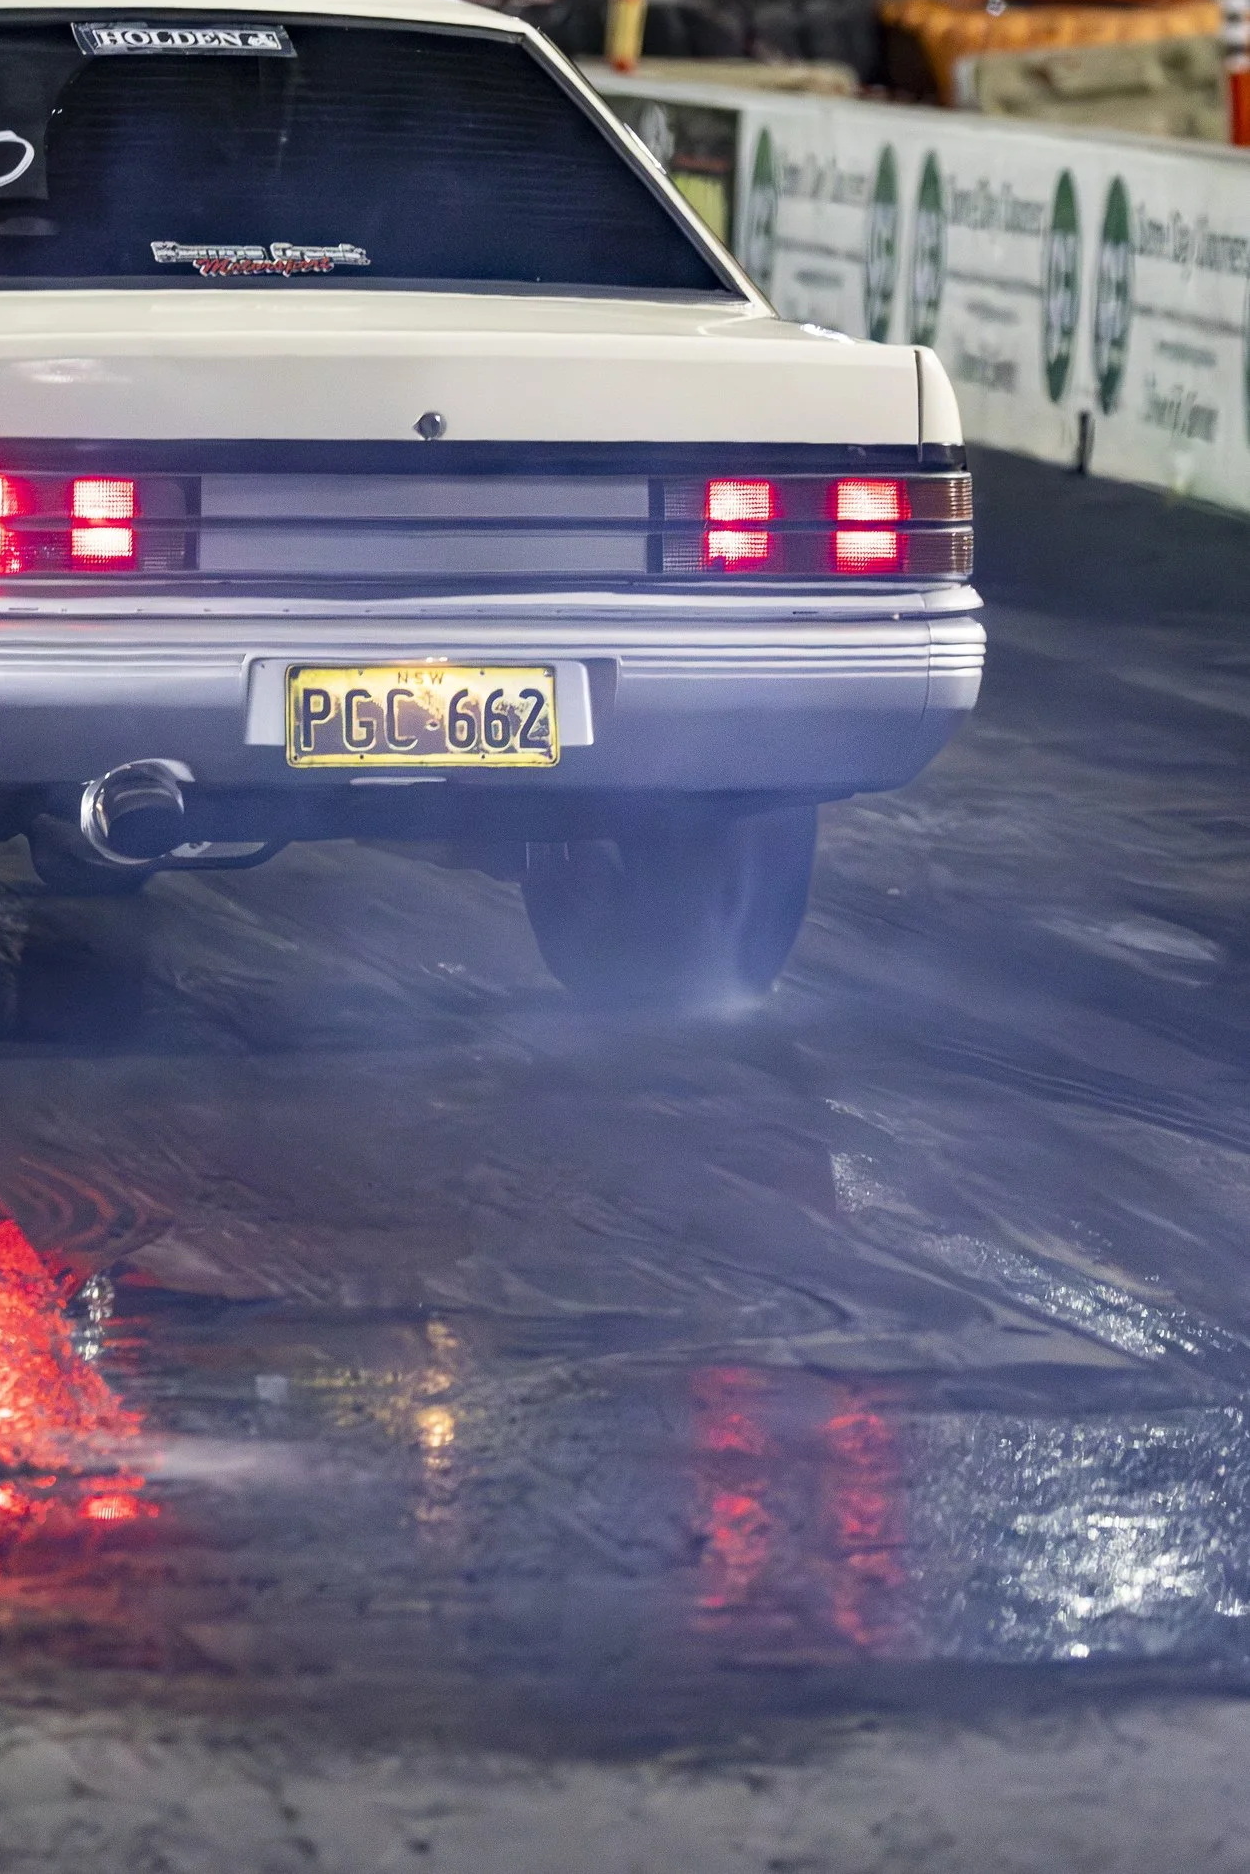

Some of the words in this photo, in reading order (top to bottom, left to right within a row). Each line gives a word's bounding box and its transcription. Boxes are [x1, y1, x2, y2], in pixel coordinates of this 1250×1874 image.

[98, 30, 243, 47] HOLDEN
[193, 256, 334, 277] Motorsport
[396, 670, 446, 686] NSW
[300, 687, 419, 753] PGC
[446, 687, 551, 754] 662
